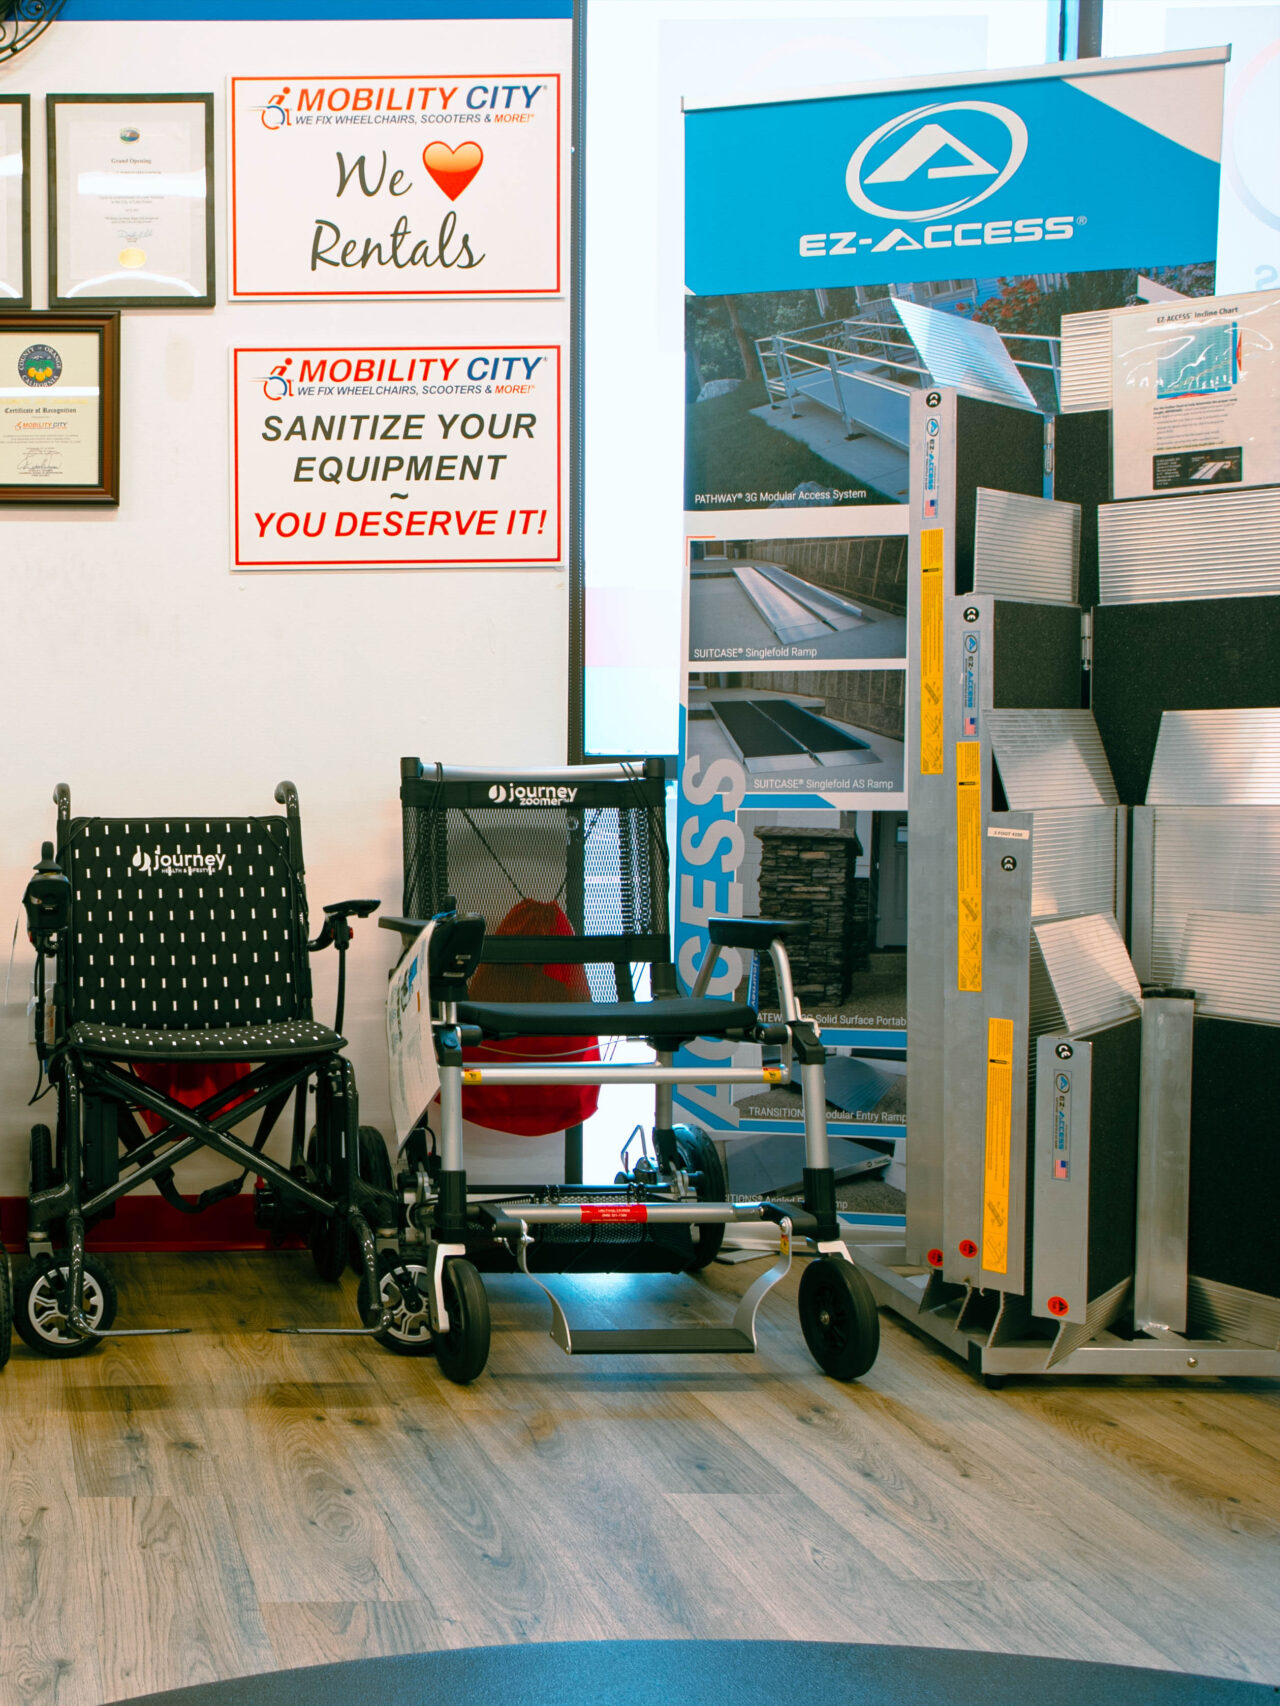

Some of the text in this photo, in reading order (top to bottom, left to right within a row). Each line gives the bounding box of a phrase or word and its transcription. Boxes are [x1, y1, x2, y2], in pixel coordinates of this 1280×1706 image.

[296, 85, 543, 112] MOBILITY CITY
[295, 115, 312, 125] WE
[315, 115, 332, 125] FIX
[335, 114, 418, 125] WHEELCHAIRS,
[420, 113, 481, 124] SCOOTERS
[484, 114, 492, 123] &
[336, 150, 413, 197] We
[311, 210, 486, 271] Rentals
[299, 357, 543, 383] MOBILITY CITY
[297, 387, 315, 396] WE
[317, 387, 335, 396] FIX
[336, 386, 418, 396] WHEELCHAIRS,
[422, 385, 482, 395] SCOOTERS
[485, 385, 492, 394] &
[261, 413, 537, 441] SANITIZE YOUR
[293, 454, 507, 484] EQUIPMENT
[745, 492, 757, 503] 3G
[760, 491, 796, 501] Modular
[798, 490, 830, 500] Access
[832, 489, 866, 501] System
[254, 509, 547, 538] YOU DESERVE IT!
[745, 647, 789, 659] Singlefold
[791, 647, 818, 659] Ramp
[508, 782, 578, 803] journey
[806, 778, 851, 790] Singlefold
[852, 779, 865, 789] AS
[867, 779, 894, 790] Ramp
[519, 798, 562, 806] zoomer
[153, 850, 227, 871] journey
[815, 1014, 907, 1026] Solid Surface Portab
[748, 1107, 804, 1118] TRANSITION
[825, 1111, 854, 1120] odular
[856, 1111, 879, 1123] Entry
